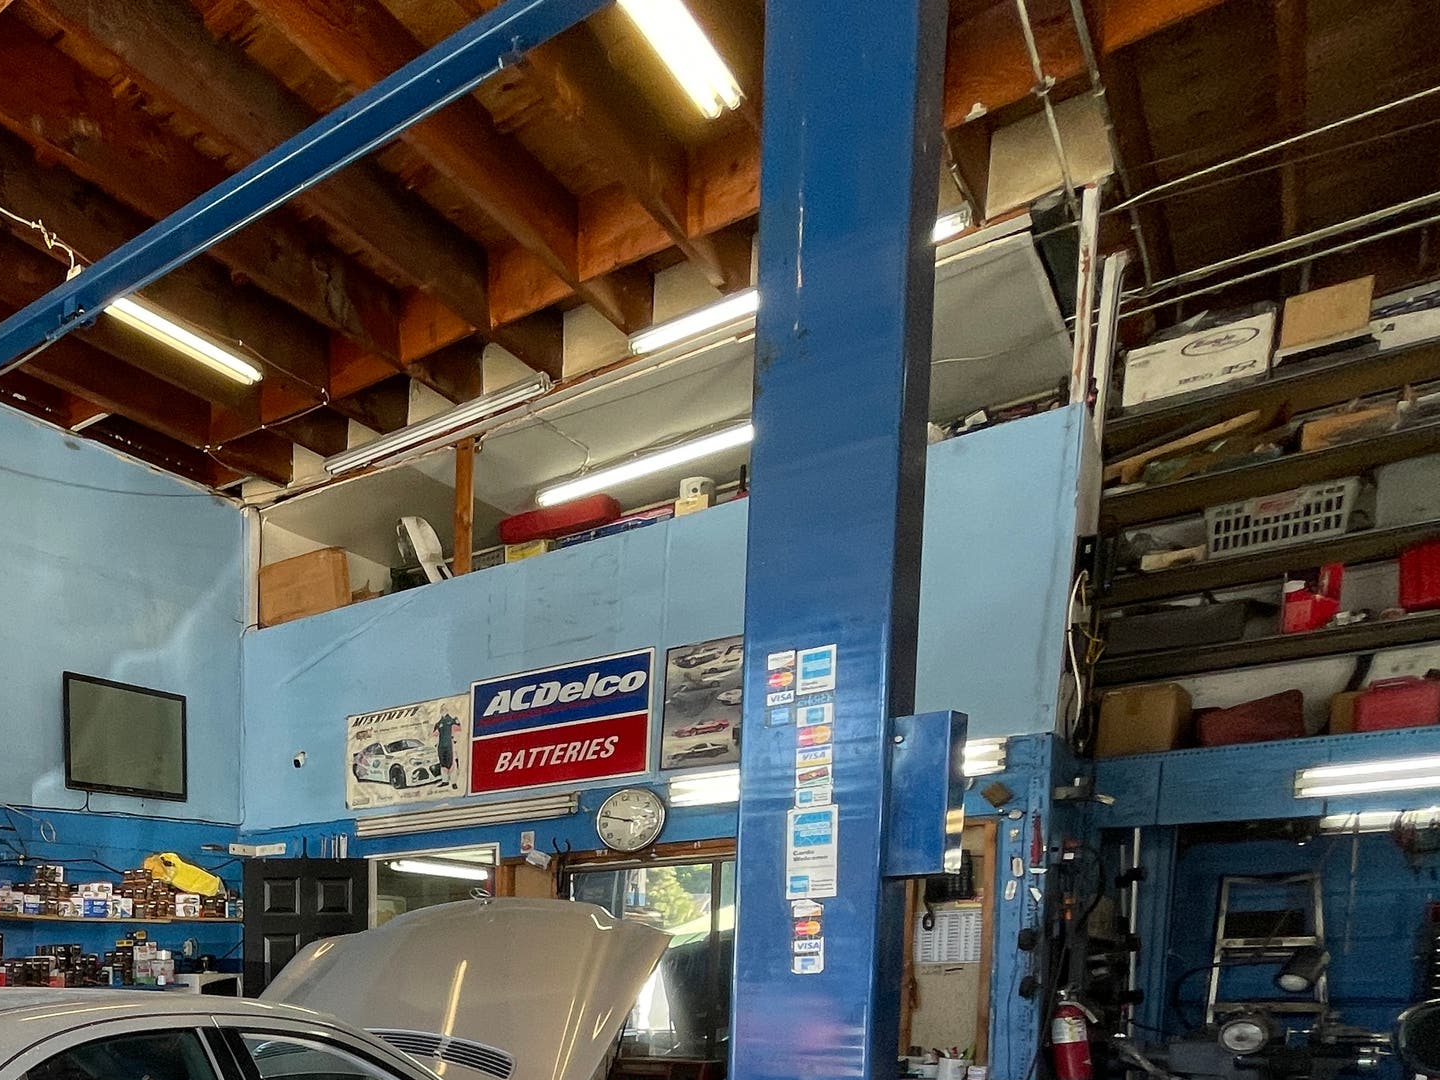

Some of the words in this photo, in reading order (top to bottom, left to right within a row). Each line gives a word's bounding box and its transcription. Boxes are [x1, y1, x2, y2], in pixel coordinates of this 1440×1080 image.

[482, 669, 648, 718] ACDelco
[770, 694, 793, 703] VISA
[494, 735, 620, 774] BATTERIES
[797, 941, 820, 950] VISA
